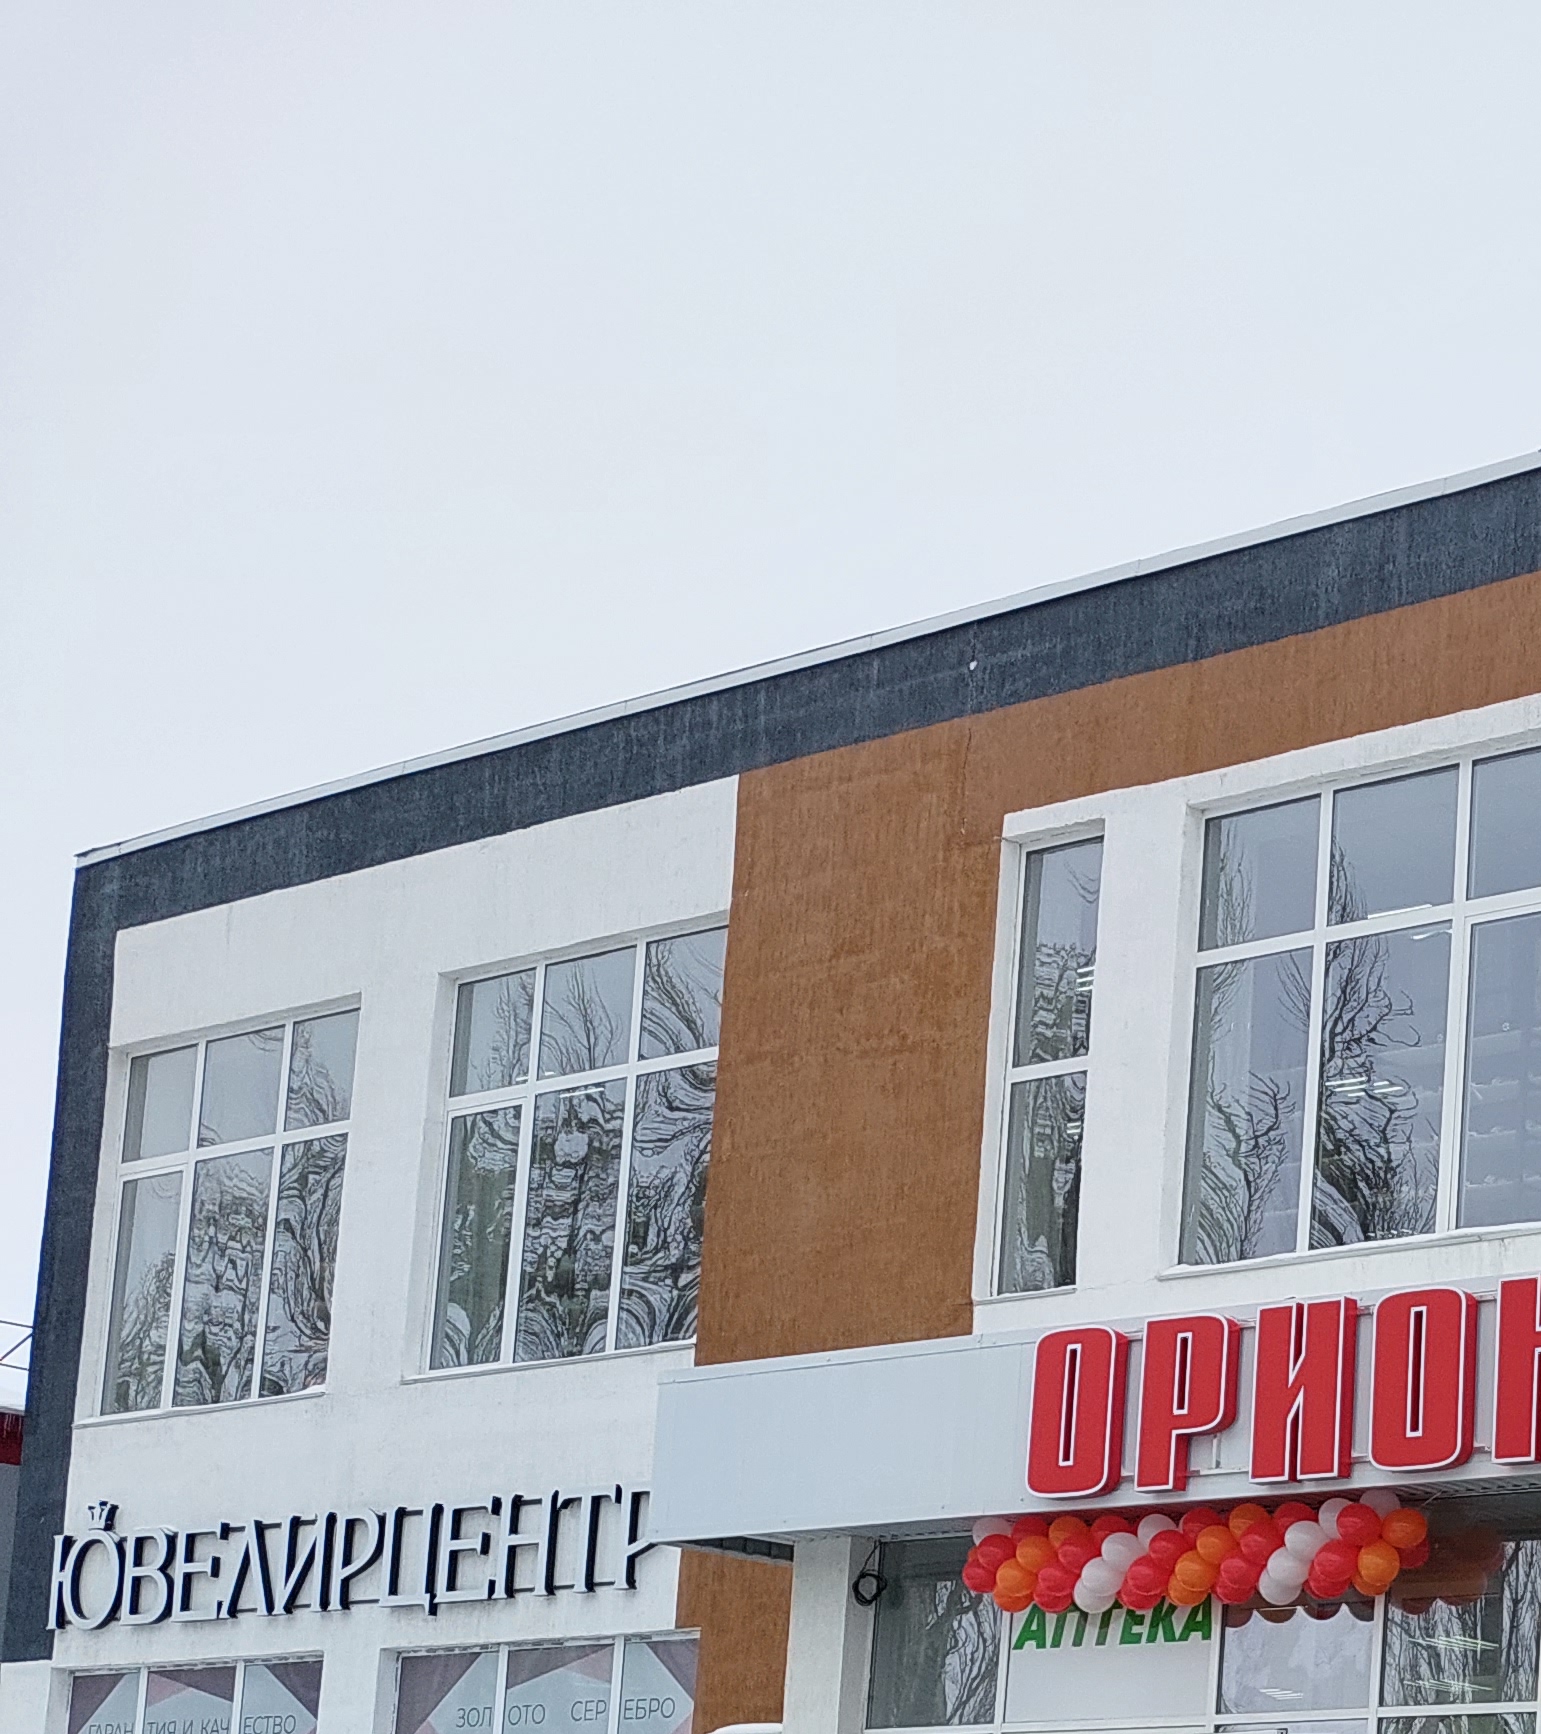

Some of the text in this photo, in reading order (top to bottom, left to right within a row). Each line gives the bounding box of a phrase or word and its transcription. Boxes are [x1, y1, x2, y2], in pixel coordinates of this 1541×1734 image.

[1011, 1593, 1212, 1651] АПТЕКА
[455, 1697, 676, 1729] ЗОЛОТО СЕРЕБРО
